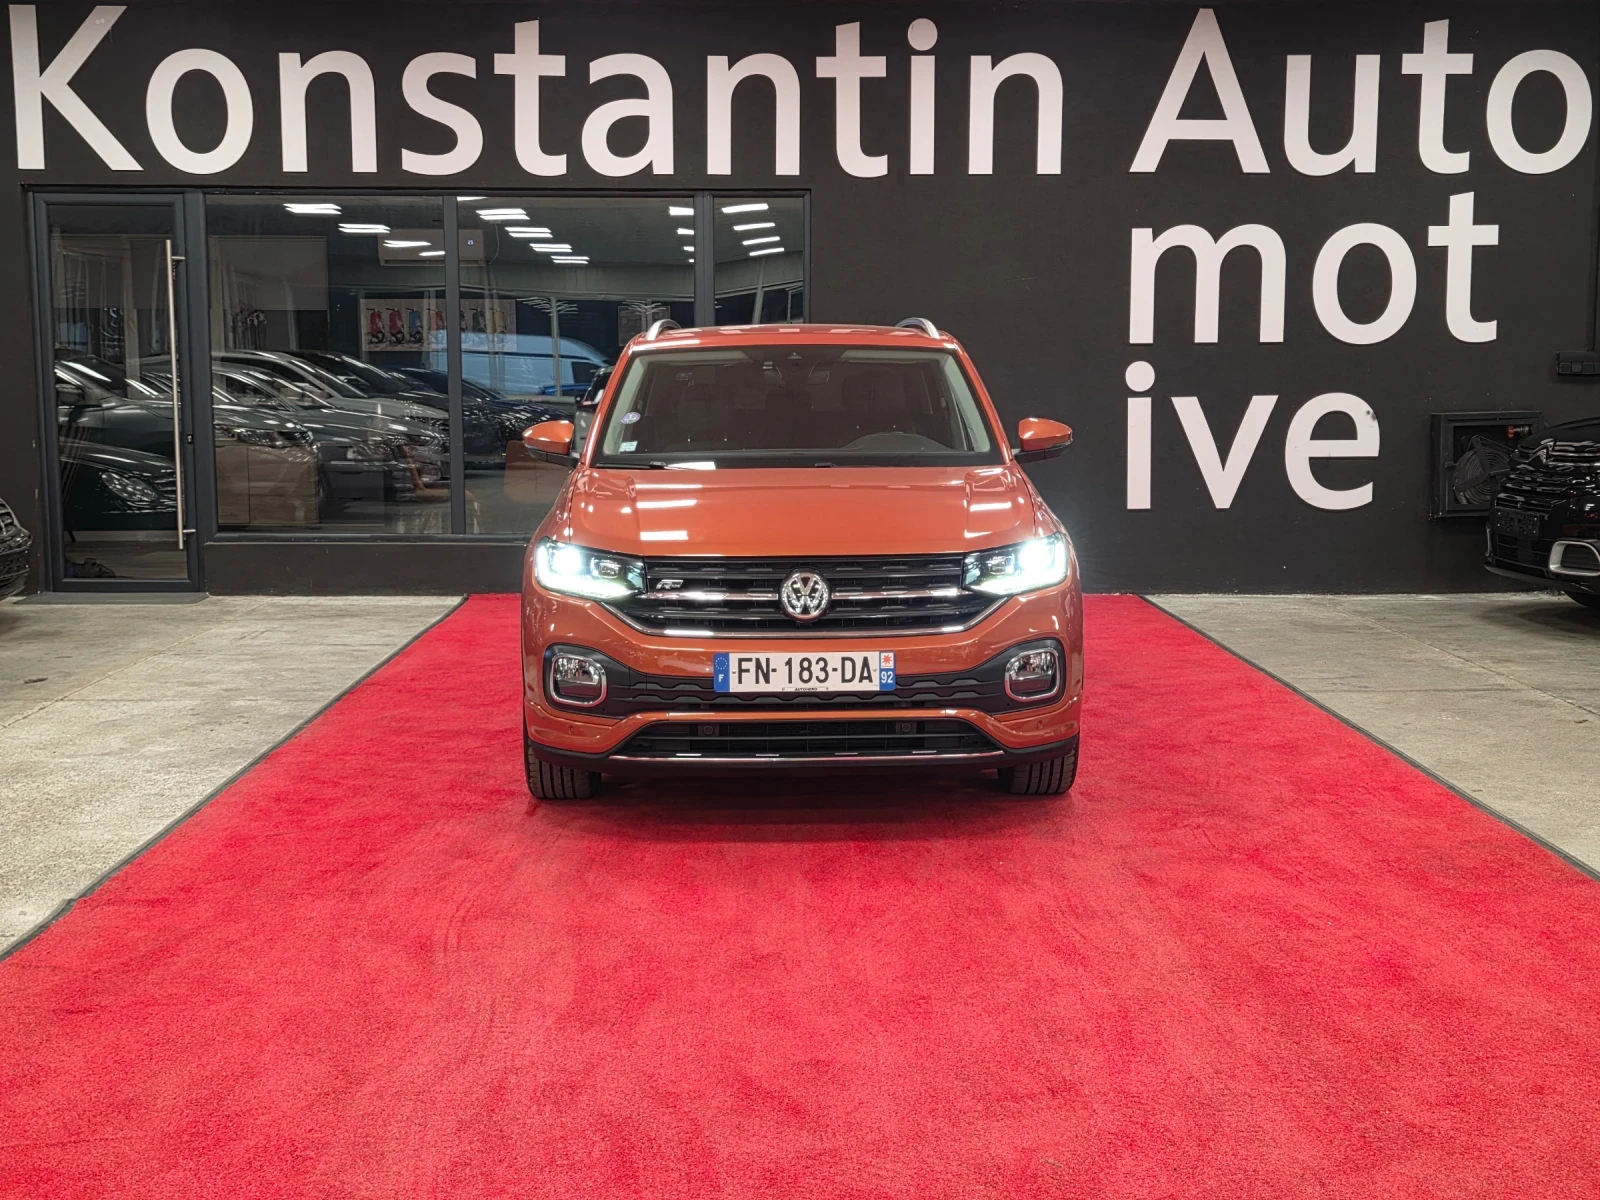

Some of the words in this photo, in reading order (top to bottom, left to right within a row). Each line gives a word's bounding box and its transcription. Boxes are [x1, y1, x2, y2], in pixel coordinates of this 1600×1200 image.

[9, 4, 1063, 177] Konstantin
[1129, 8, 1592, 176] Auto
[1128, 192, 1499, 344] mot
[1126, 361, 1380, 509] ive
[718, 674, 725, 682] F
[737, 656, 873, 685] FN-183-DA
[880, 671, 894, 684] 92
